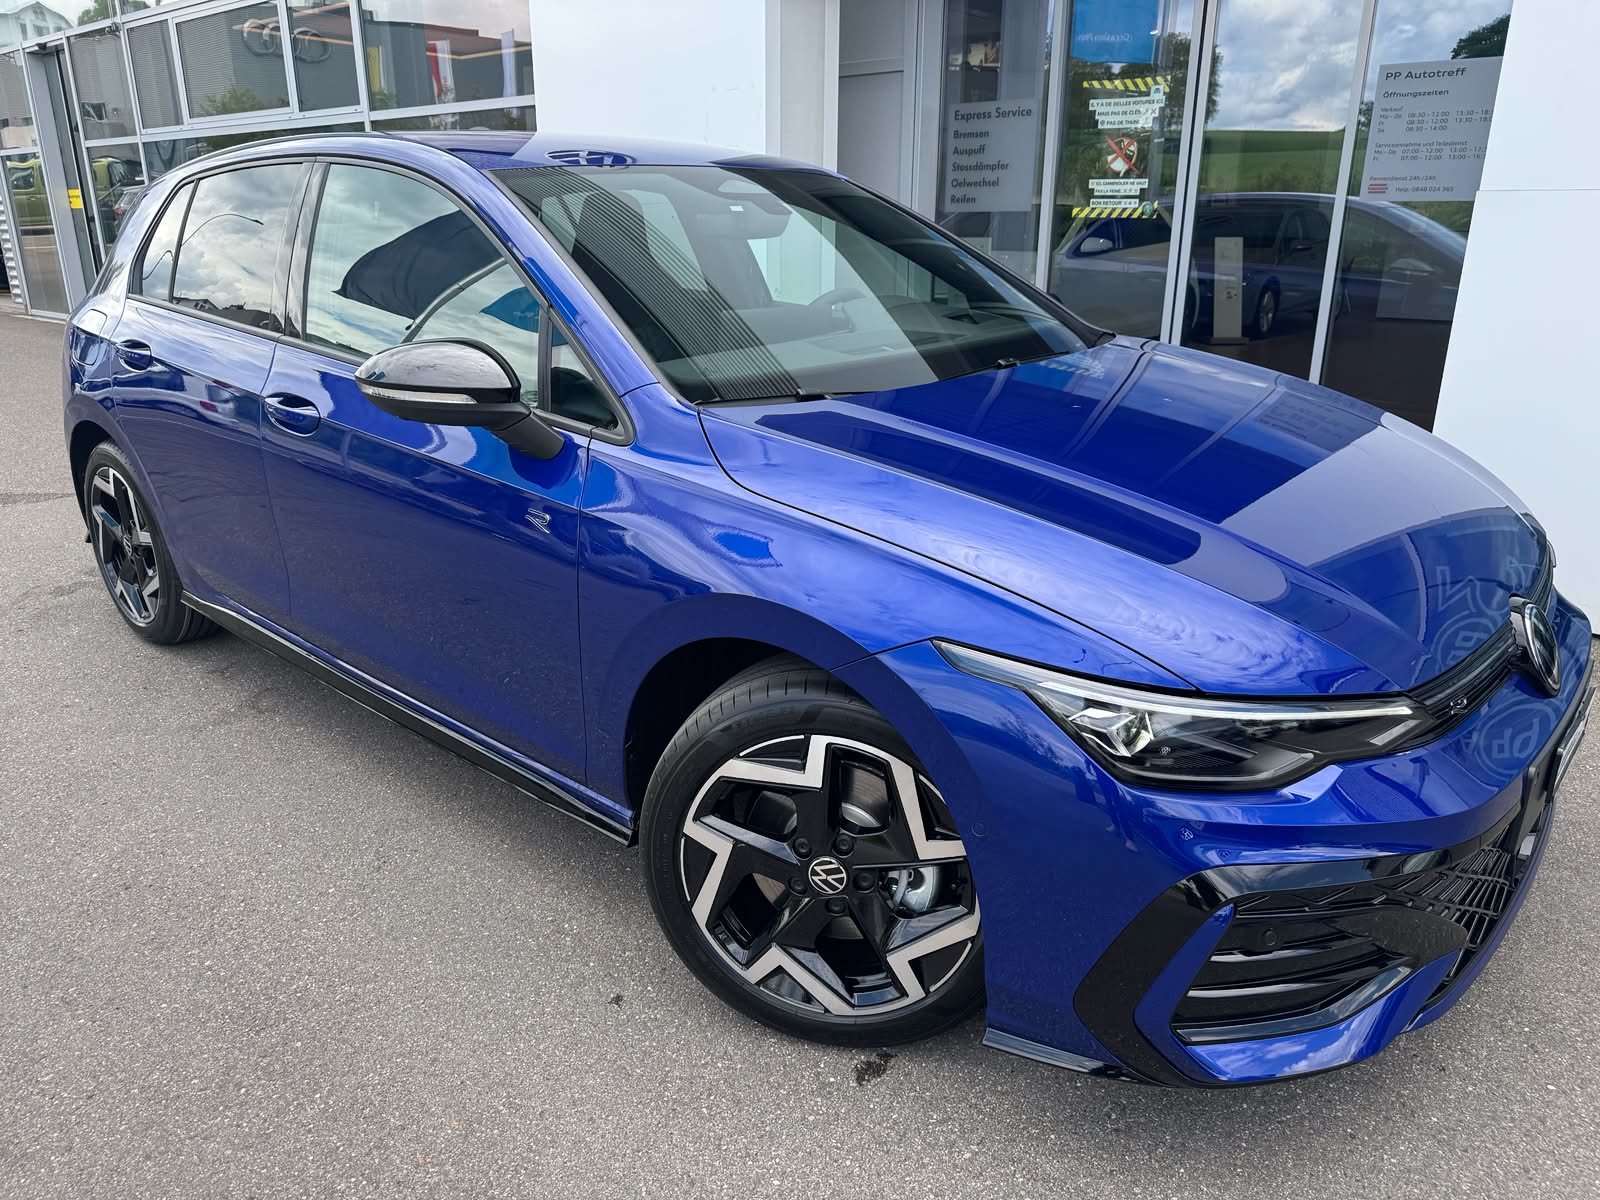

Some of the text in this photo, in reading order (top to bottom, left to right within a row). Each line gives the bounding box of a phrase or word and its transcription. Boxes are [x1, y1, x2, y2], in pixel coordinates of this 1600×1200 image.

[1385, 67, 1467, 80] PP Autotreff
[1383, 89, 1449, 98] Öffnungszeiten
[954, 106, 1032, 123] Express Service
[953, 129, 990, 139] Bremsen
[952, 144, 986, 157] Auspuff
[952, 160, 1009, 173] Stossdämpfer
[951, 177, 999, 189] Oelwechsel
[950, 194, 976, 204] Reifen
